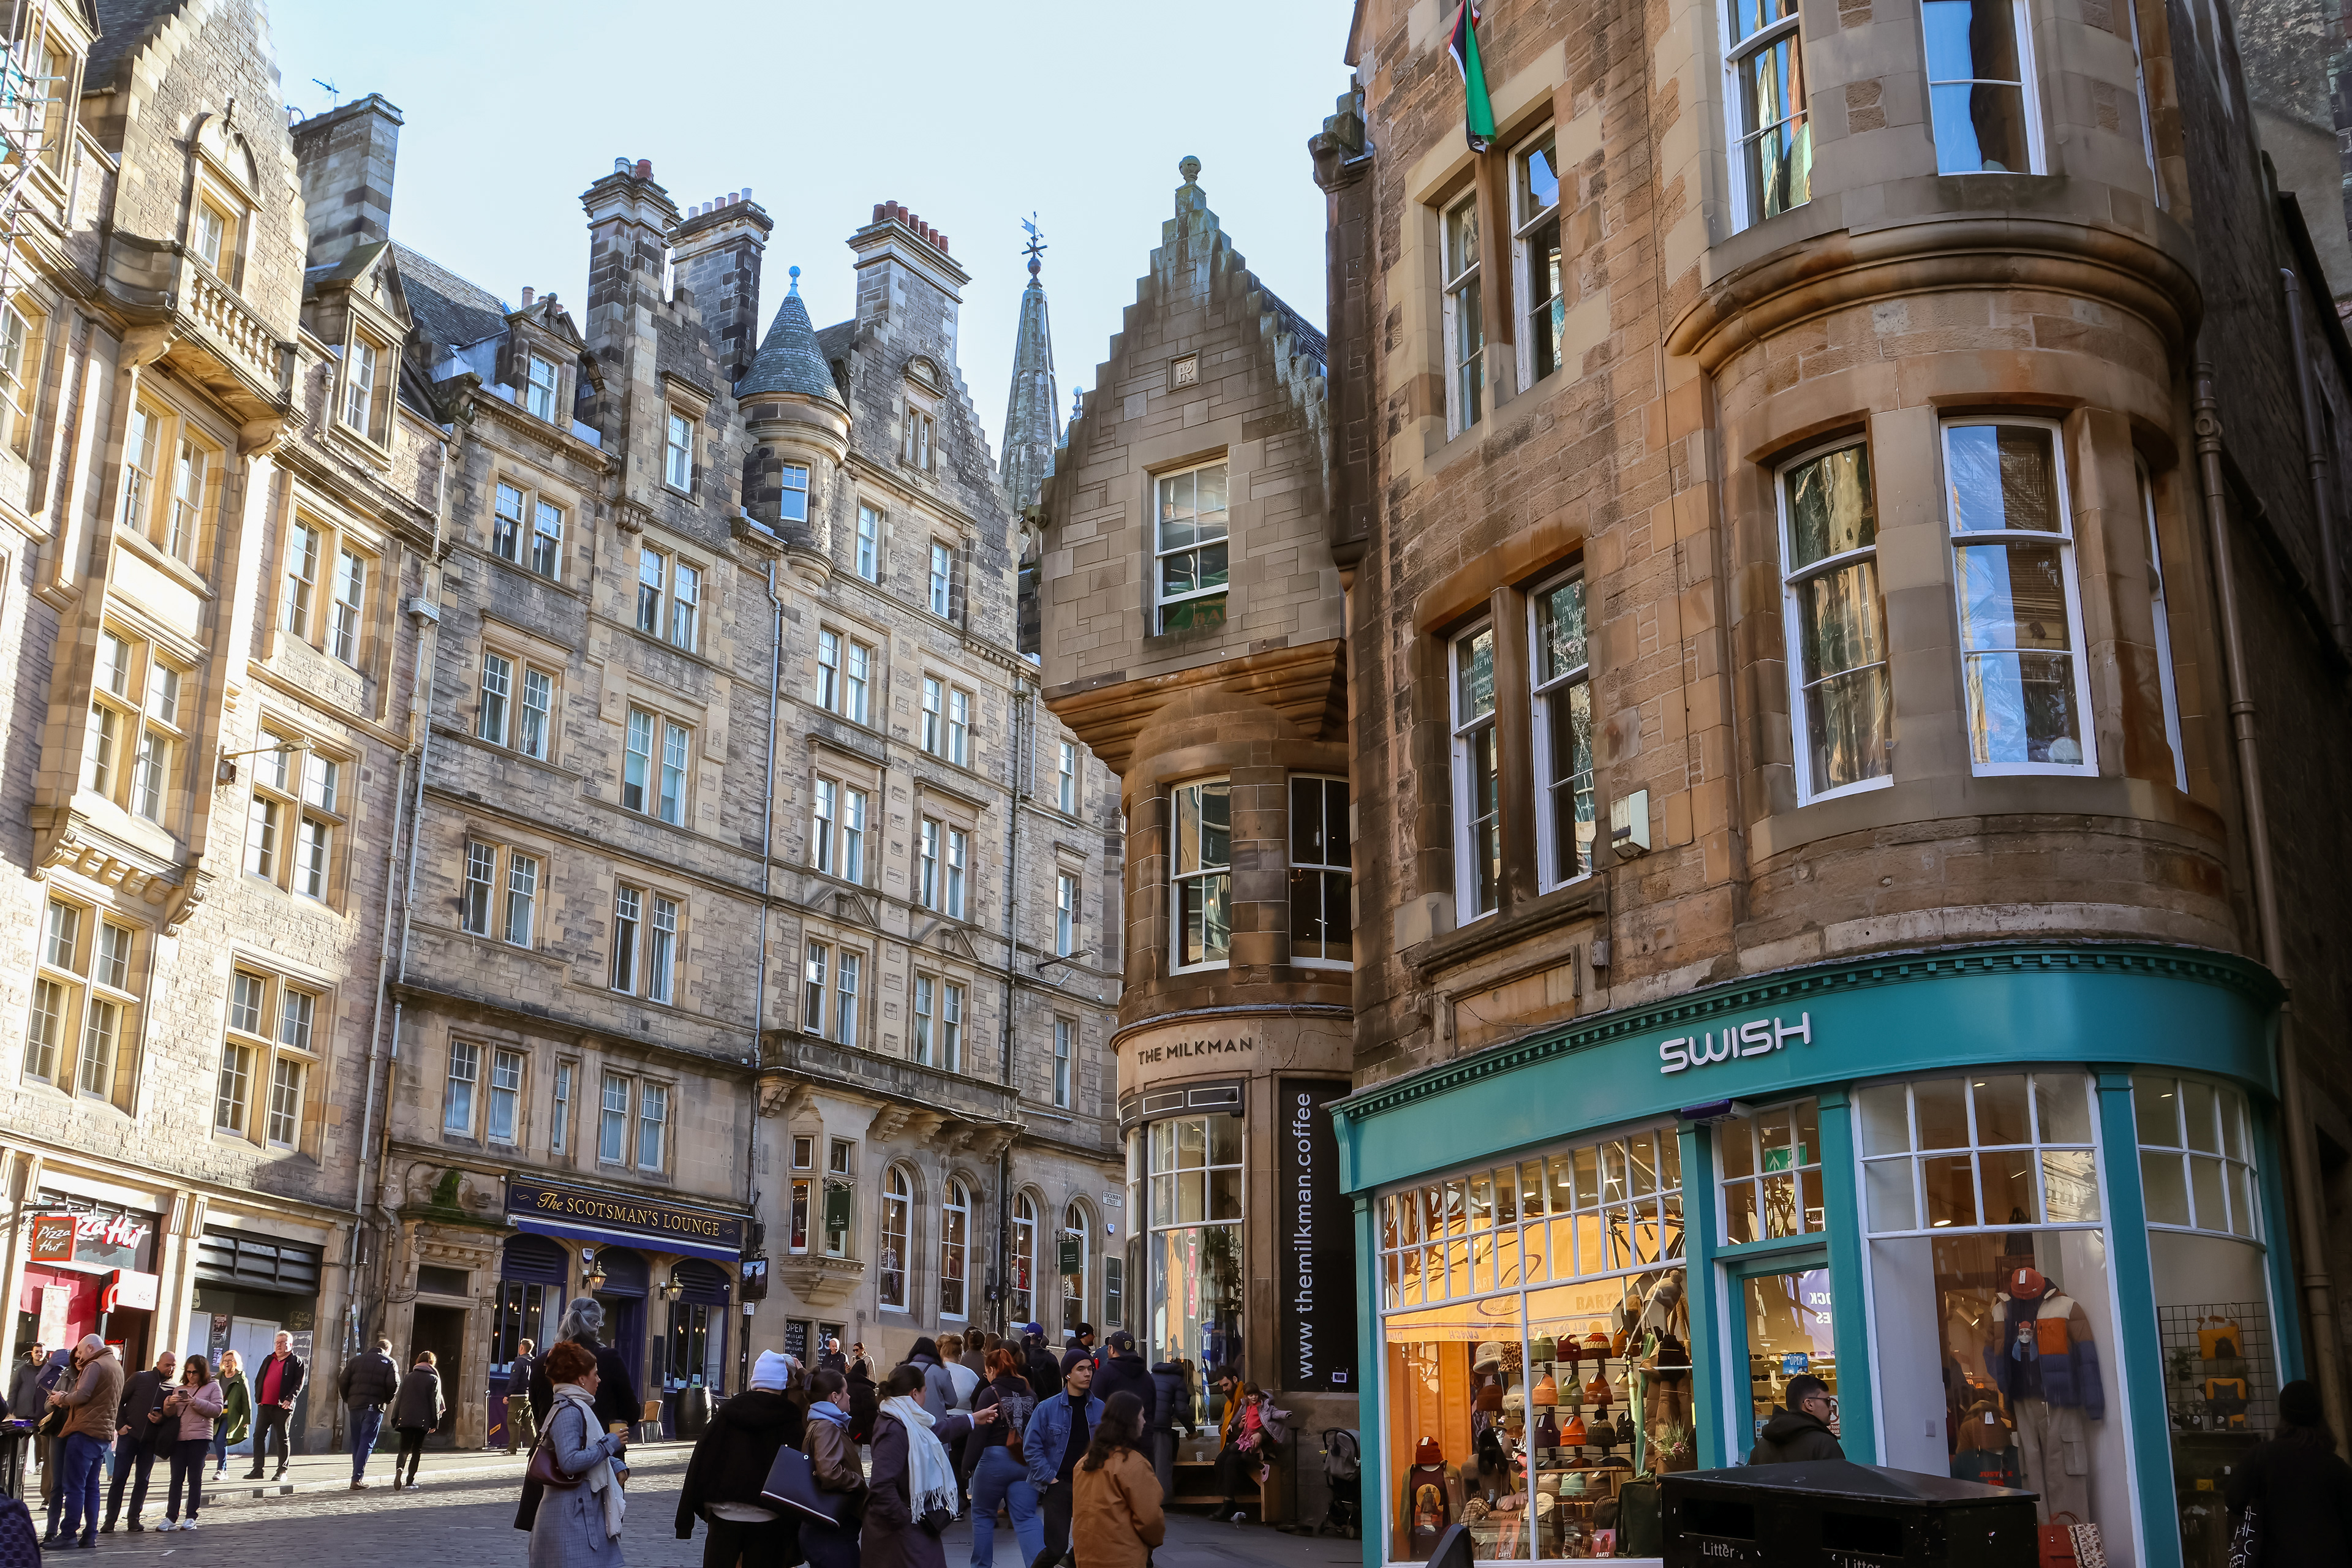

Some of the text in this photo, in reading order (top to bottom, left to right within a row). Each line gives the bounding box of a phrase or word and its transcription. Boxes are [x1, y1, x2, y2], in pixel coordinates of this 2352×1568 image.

[1461, 661, 1483, 679] WHOLE
[1476, 683, 1491, 696] Health
[1138, 1037, 1252, 1065] THE MILKMAN
[1660, 1012, 1811, 1074] SWISH
[1104, 1192, 1121, 1200] COCKBURN
[537, 1193, 720, 1236] The SCOTSMAN'S LOUNGE
[37, 1226, 71, 1239] Pizza
[106, 1215, 151, 1249] Hut
[1293, 1093, 1313, 1379] www themilkman.coffee
[39, 1240, 66, 1252] Hut
[786, 1322, 803, 1333] OPEN
[1703, 1541, 1735, 1558] Litter
